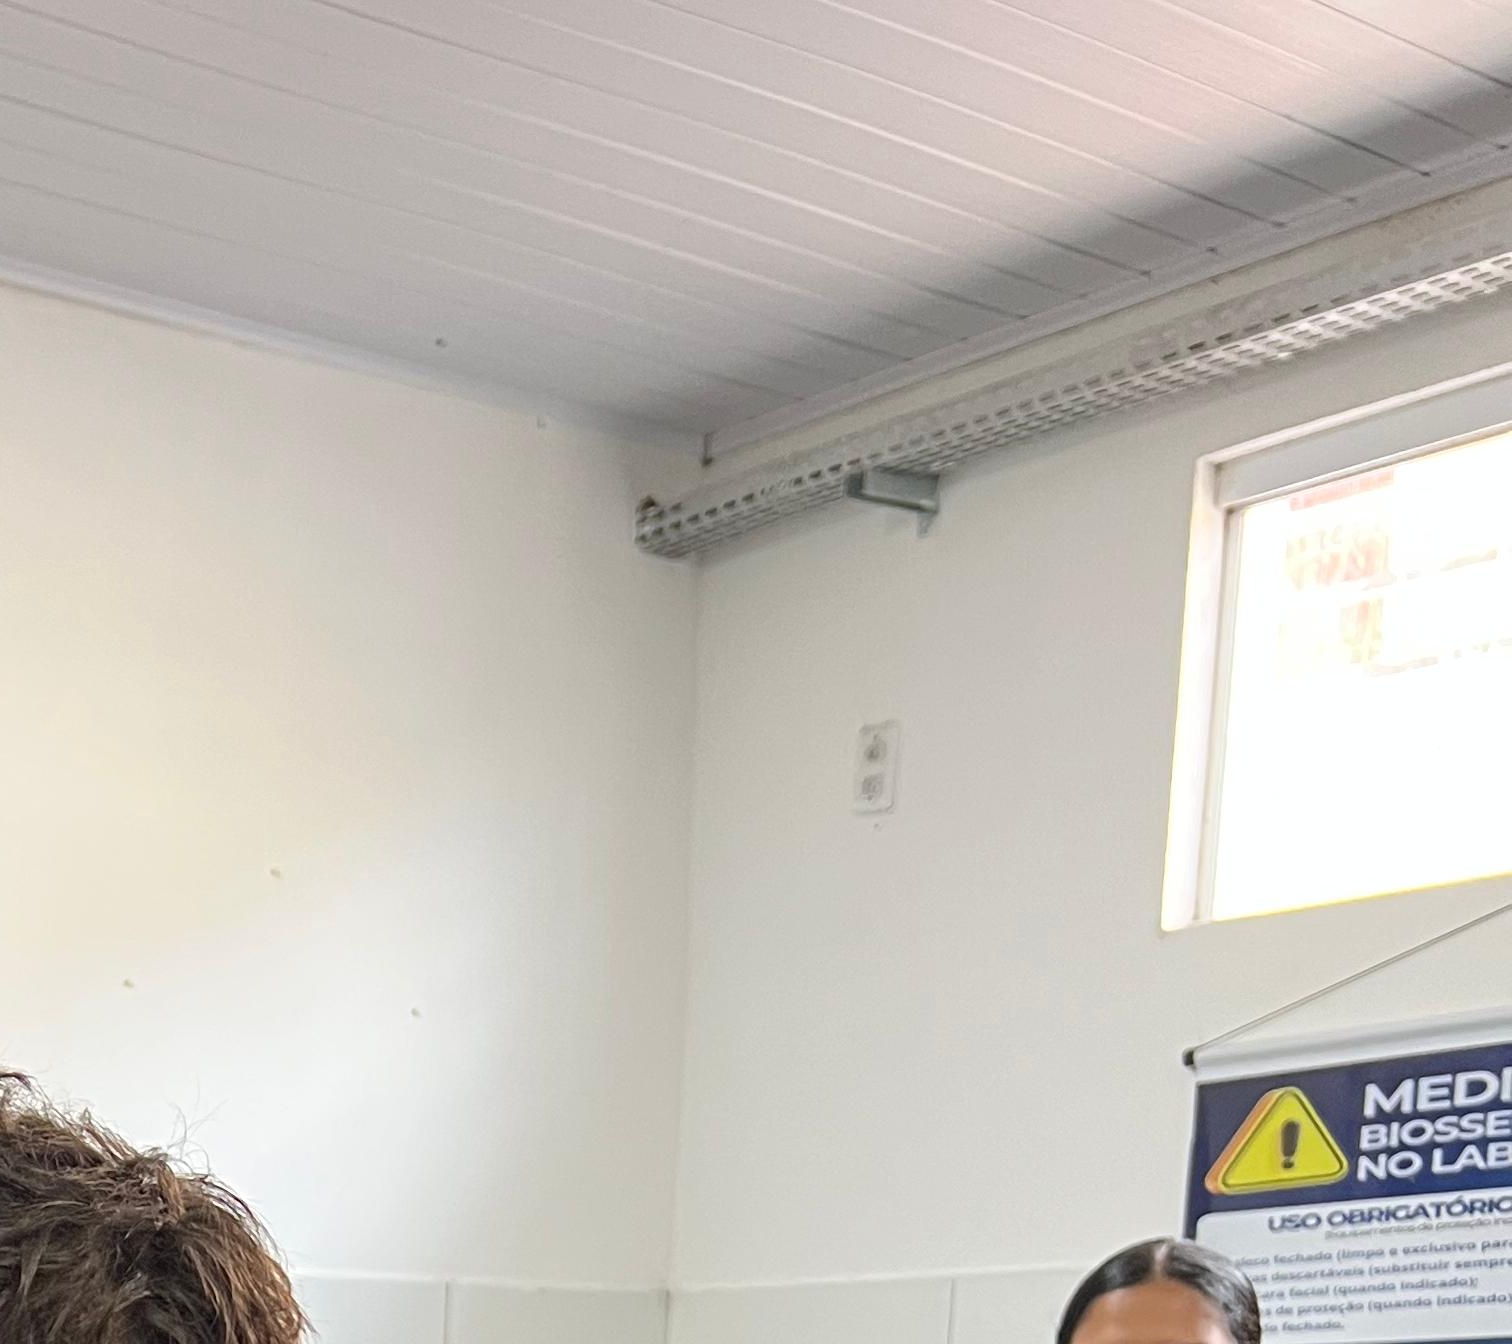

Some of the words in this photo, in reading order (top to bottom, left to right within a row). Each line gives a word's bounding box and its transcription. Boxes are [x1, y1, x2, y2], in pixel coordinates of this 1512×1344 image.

[1363, 1066, 1512, 1119] MEDI
[1359, 1109, 1512, 1151] BIOSSE
[1357, 1150, 1423, 1182] NO
[1431, 1141, 1512, 1174] LAB
[1268, 1212, 1322, 1232] USO
[1389, 1249, 1398, 1257] e
[1402, 1241, 1476, 1255] exclusivo
